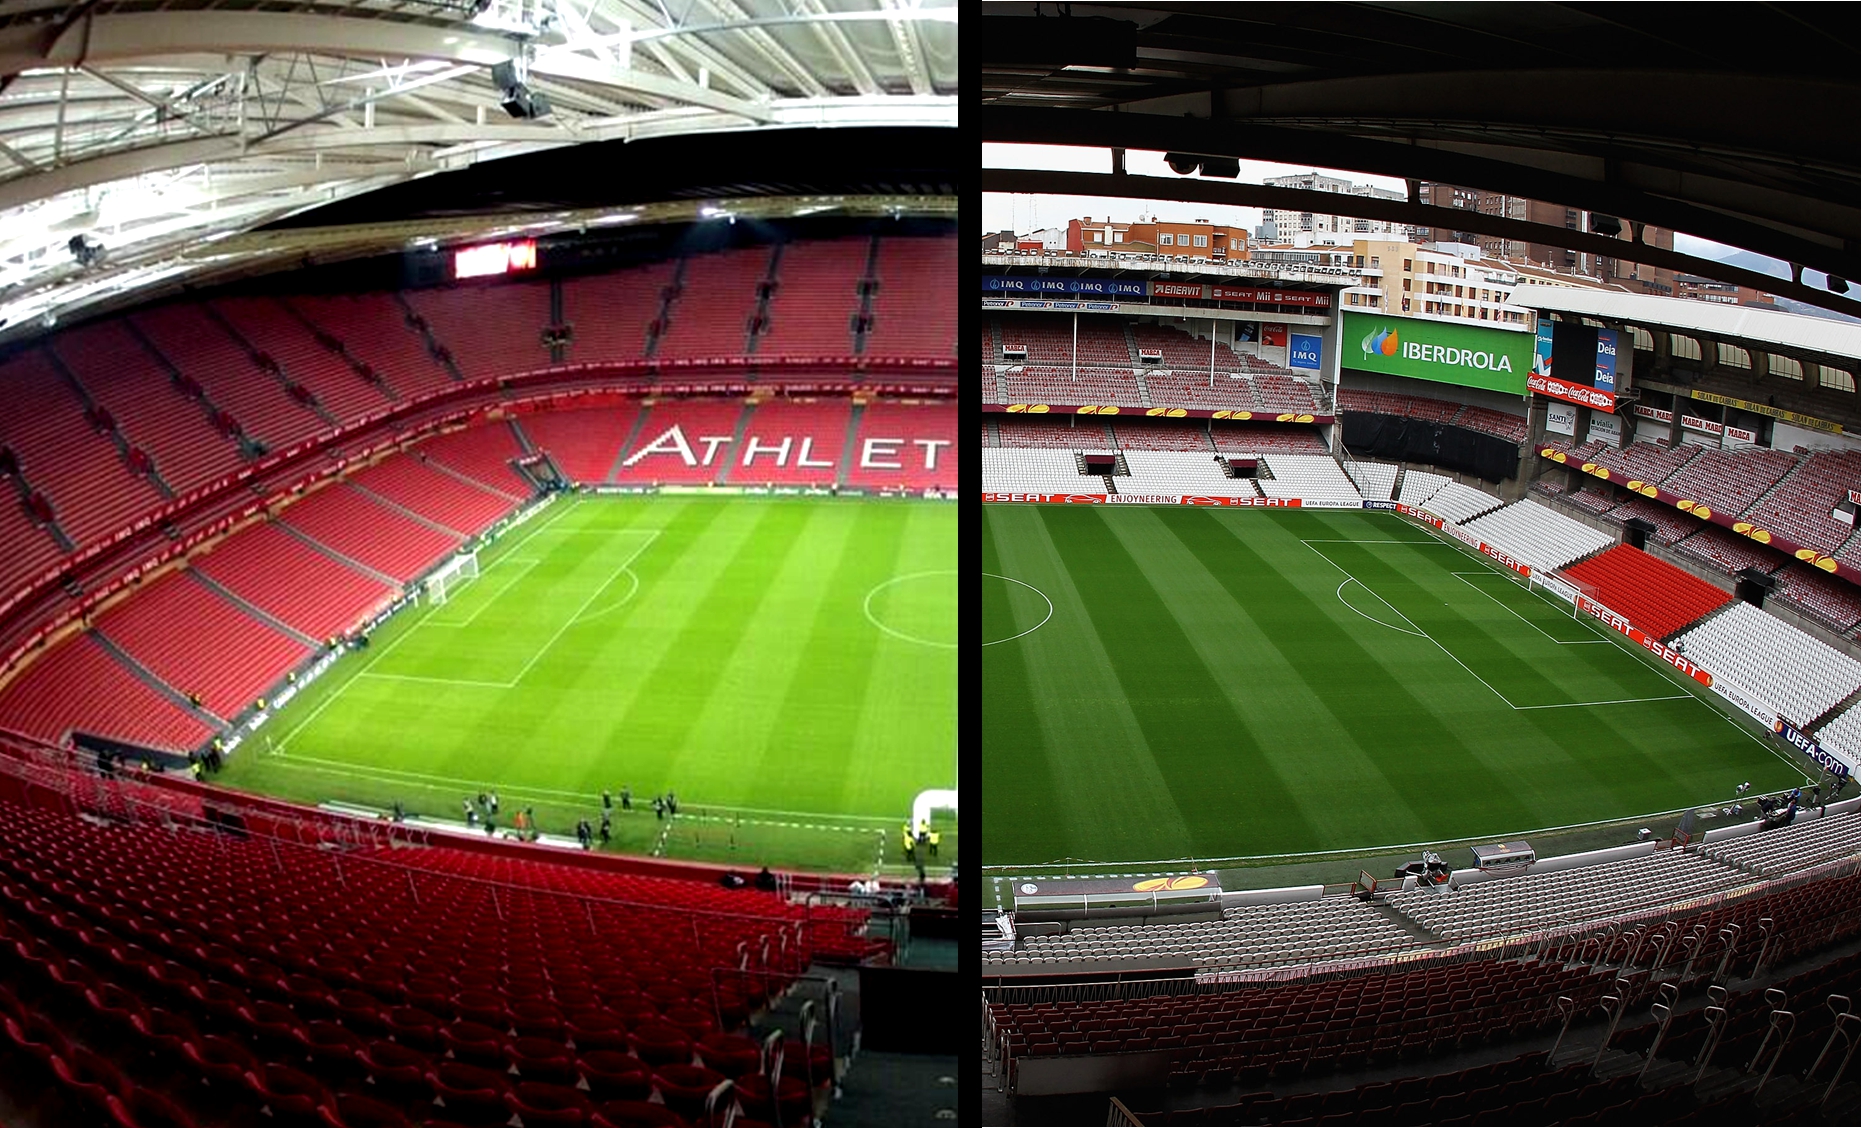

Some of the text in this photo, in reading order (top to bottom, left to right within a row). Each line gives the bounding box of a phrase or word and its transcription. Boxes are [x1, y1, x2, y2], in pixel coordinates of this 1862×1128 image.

[1000, 280, 1024, 290] IMQ
[1042, 281, 1065, 291] IMQ
[1080, 282, 1102, 293] IMQ
[1118, 284, 1141, 294] IMQ
[1164, 285, 1202, 296] ENERVIT
[1256, 291, 1271, 302] Mii
[1315, 295, 1330, 306] Mii
[1293, 350, 1317, 362] IMQ
[1402, 341, 1513, 373] IBERDROLA
[1682, 416, 1703, 429] MARCA
[1727, 427, 1750, 441] MARCA
[996, 493, 1055, 502] SEAT
[1111, 494, 1177, 504] ENJOYNEERING
[1239, 497, 1293, 506] SEAT
[1372, 501, 1396, 510] RESPECT
[1408, 506, 1439, 527] SEAT
[1443, 523, 1478, 549] ENJOYNEERING
[1490, 548, 1523, 572] SEAT
[1591, 605, 1634, 636] SEAT
[1651, 641, 1701, 678] SEAT
[1714, 681, 1774, 726] UEFA EUROPA LEAGUE
